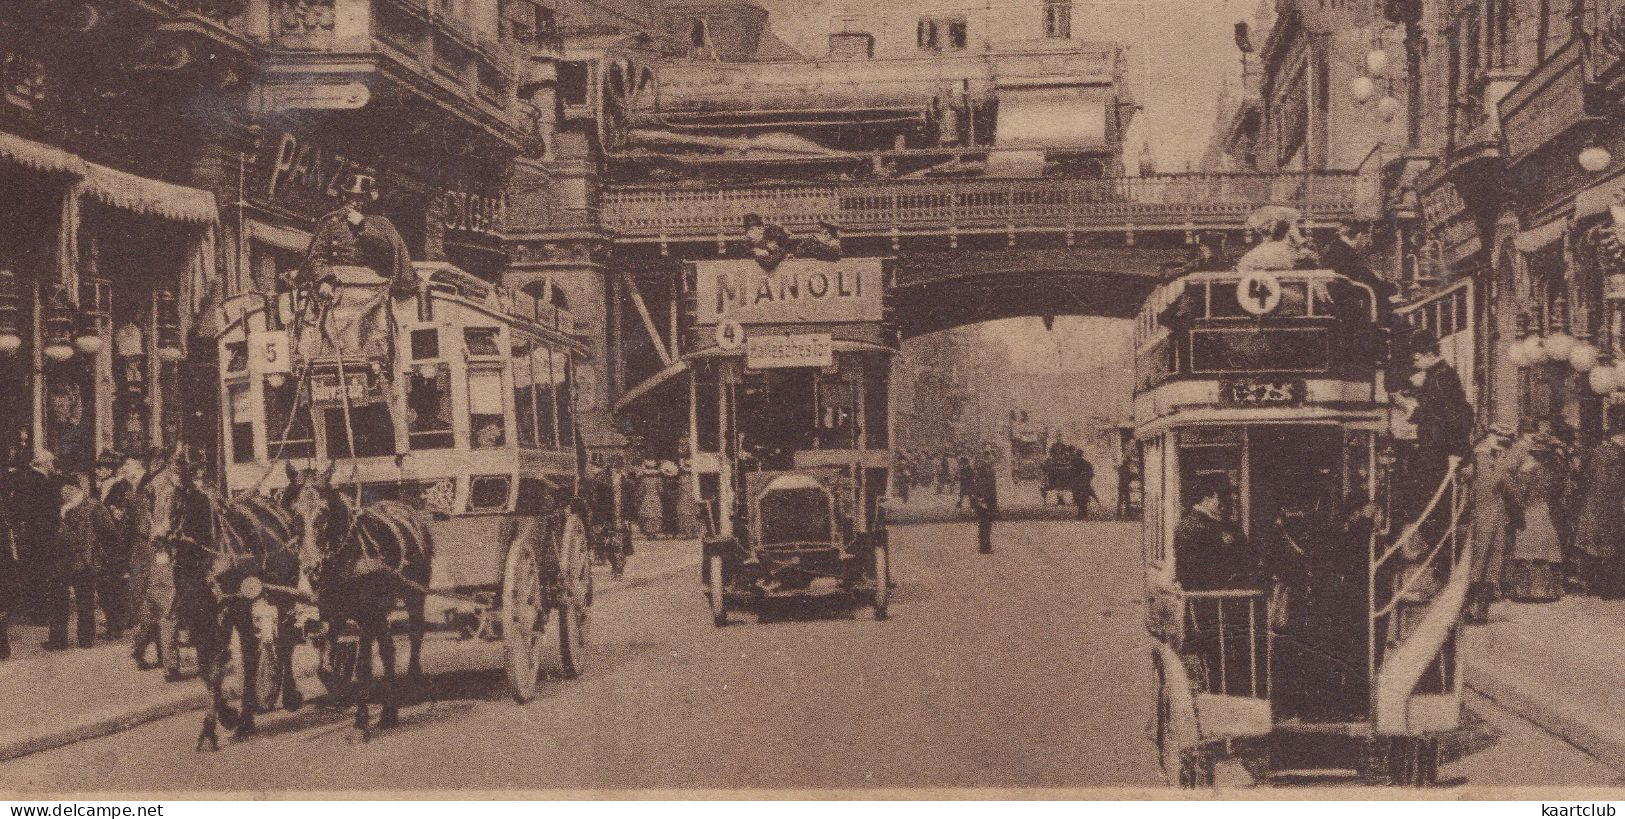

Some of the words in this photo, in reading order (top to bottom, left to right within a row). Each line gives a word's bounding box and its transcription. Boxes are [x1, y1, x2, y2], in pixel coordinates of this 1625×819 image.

[716, 271, 861, 314] MANOLI
[1248, 280, 1272, 309] 4
[723, 324, 735, 342] 4
[266, 342, 277, 362] 5
